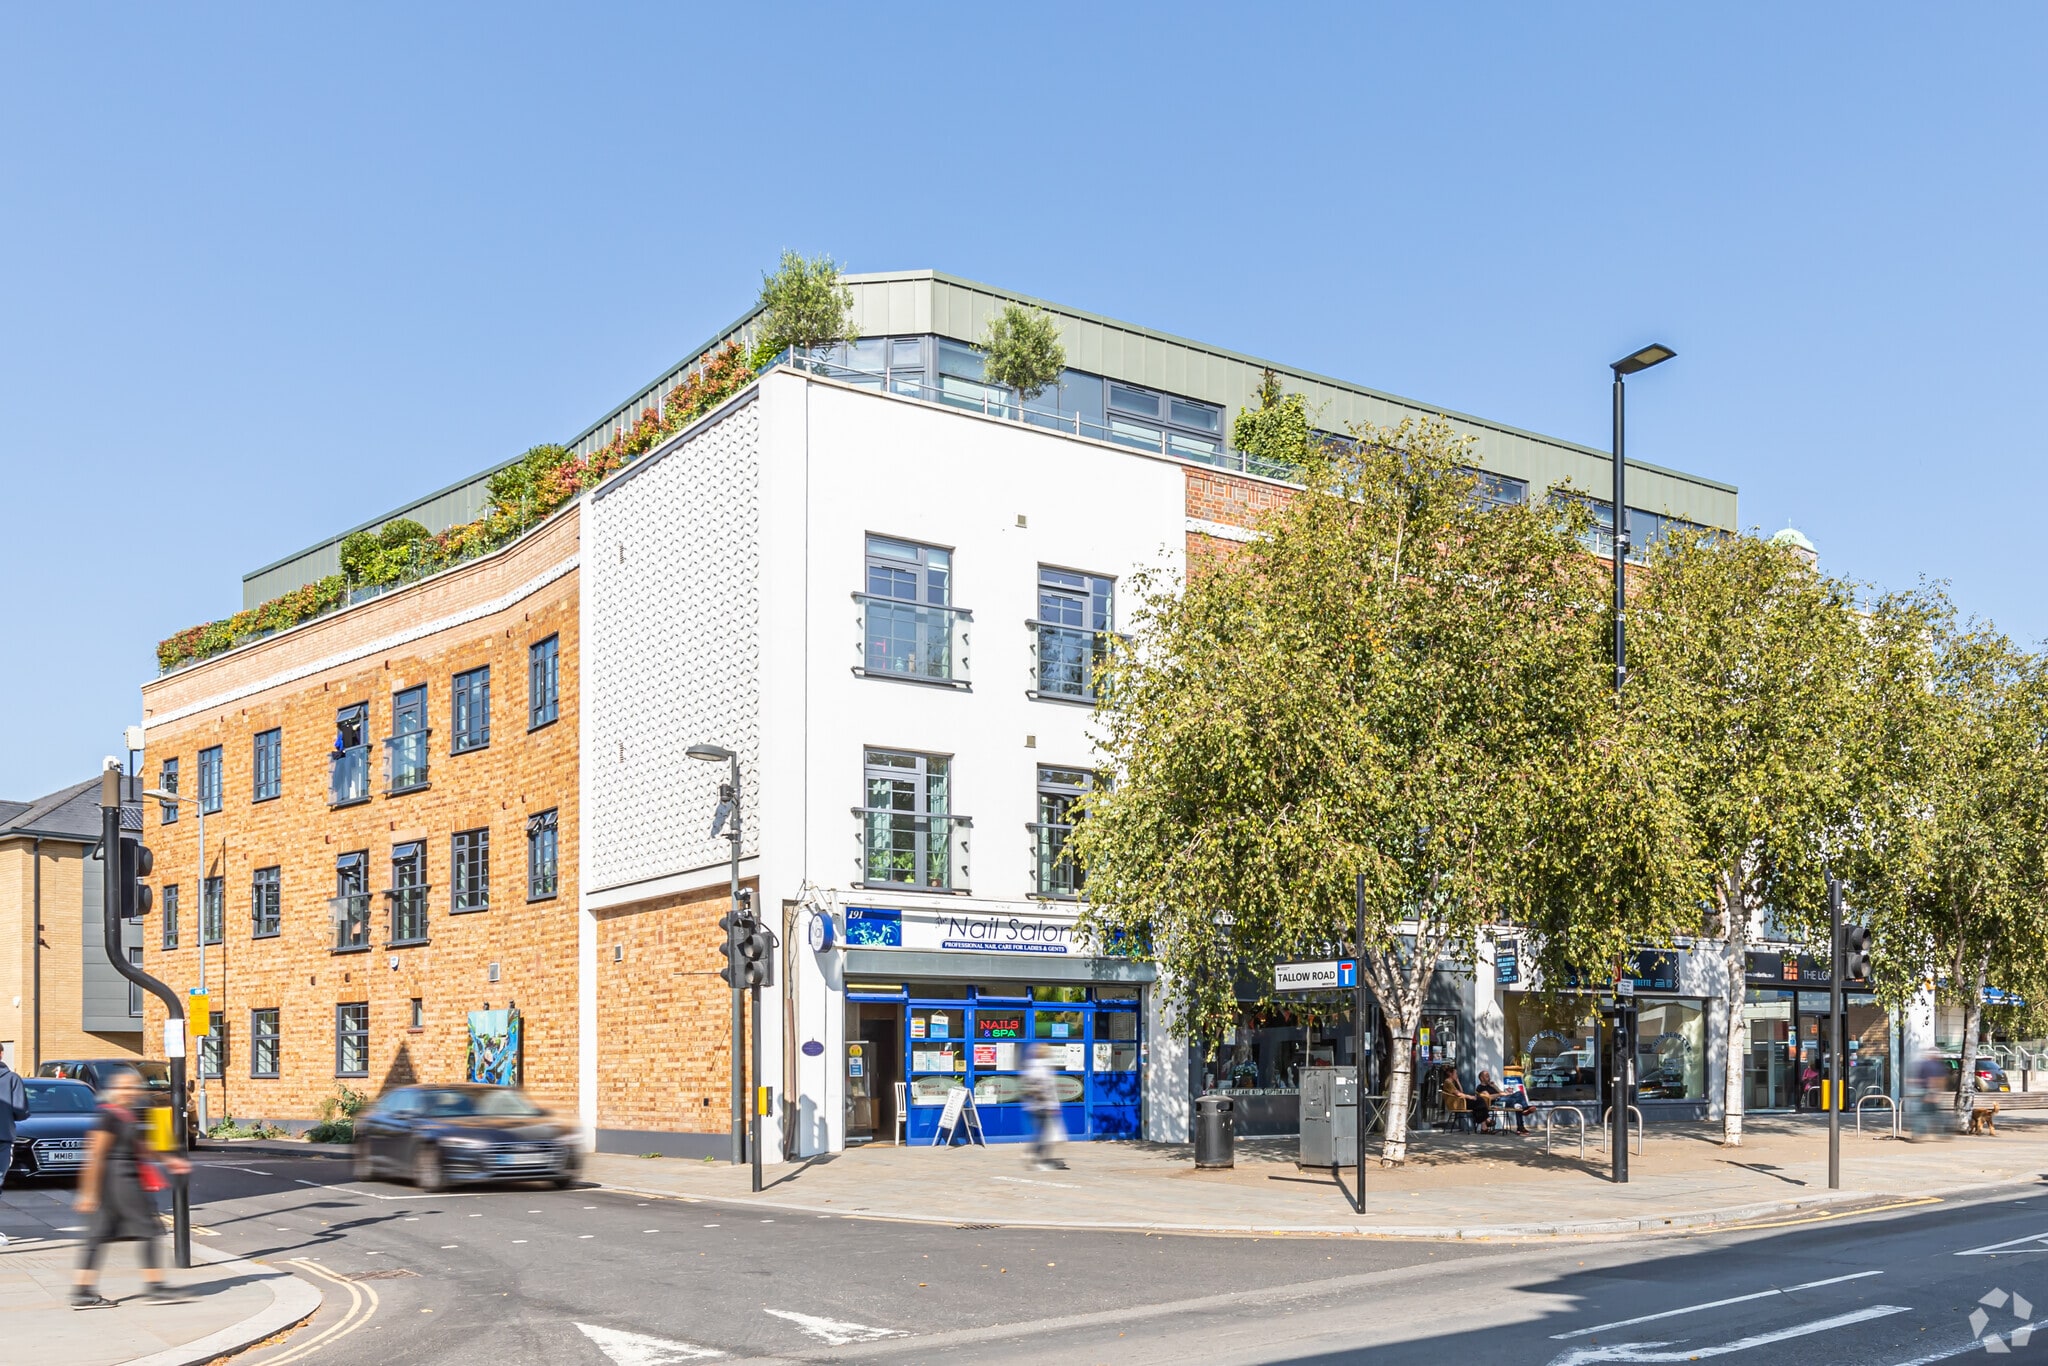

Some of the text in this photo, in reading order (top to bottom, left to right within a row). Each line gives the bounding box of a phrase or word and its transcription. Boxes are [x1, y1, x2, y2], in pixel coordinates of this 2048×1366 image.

[848, 910, 864, 919] 191
[948, 916, 999, 939] Nail
[1006, 918, 1073, 942] Salon
[1278, 970, 1336, 983] TALLOW ROAD
[1803, 970, 1817, 980] THE
[980, 1020, 1019, 1029] NAILS
[992, 1029, 1016, 1037] SPA
